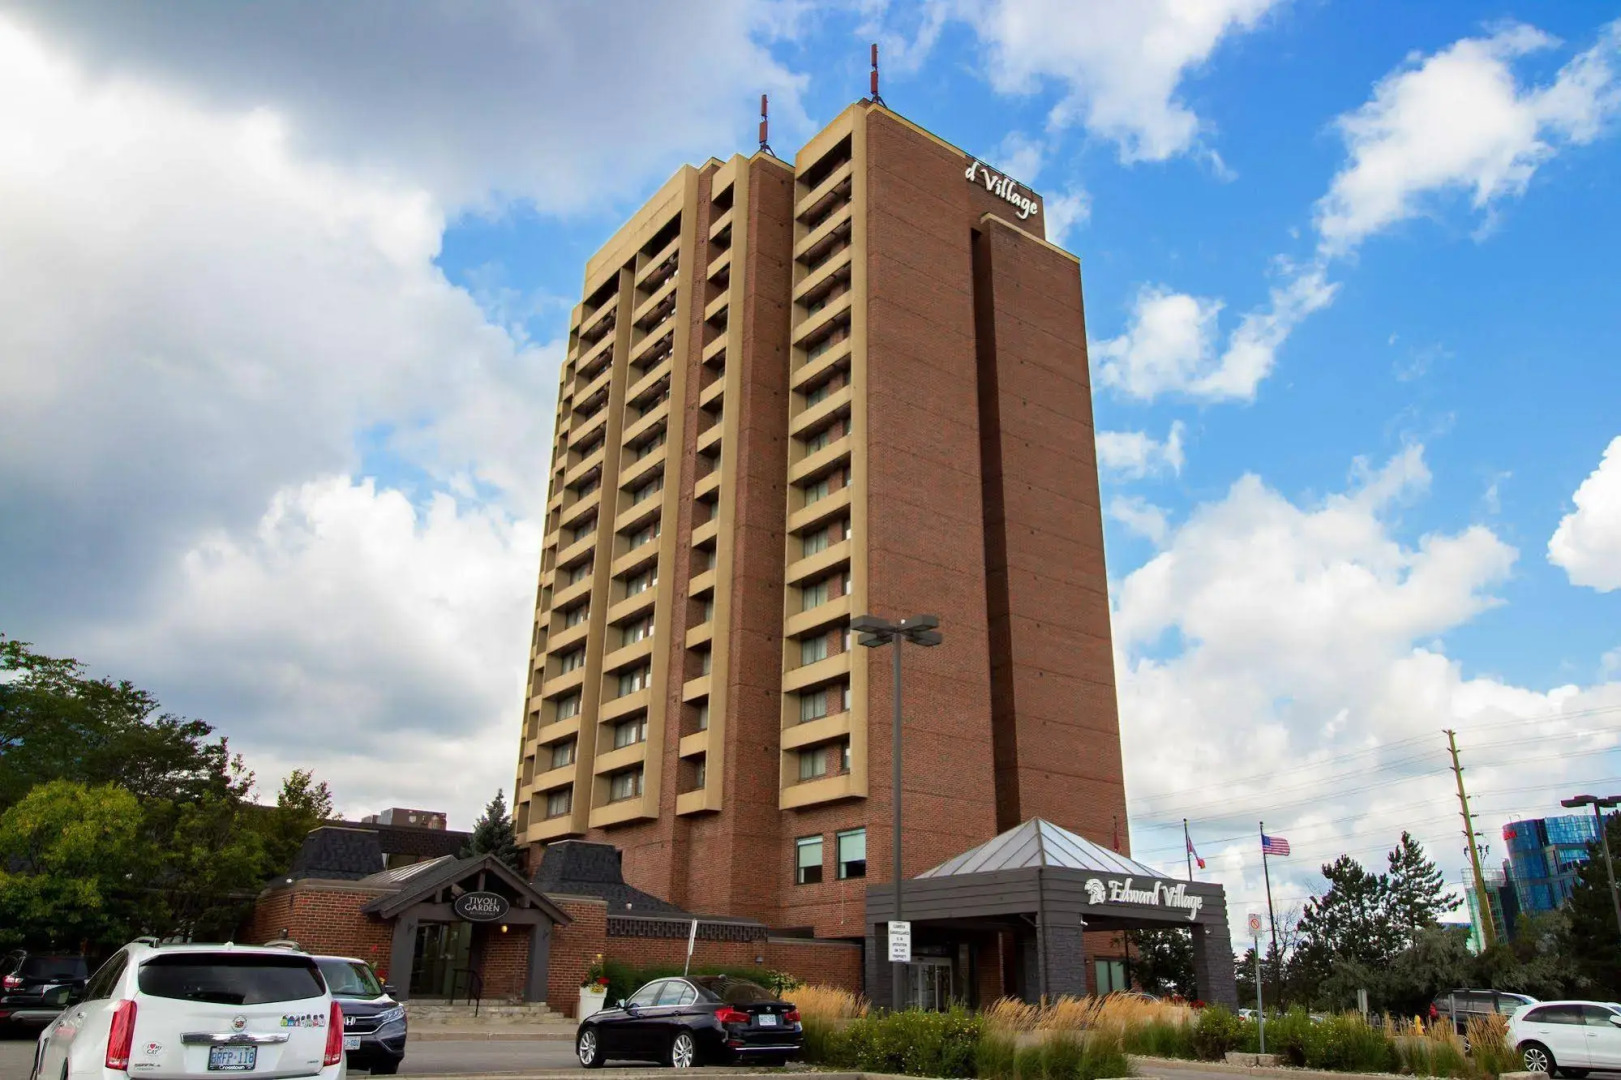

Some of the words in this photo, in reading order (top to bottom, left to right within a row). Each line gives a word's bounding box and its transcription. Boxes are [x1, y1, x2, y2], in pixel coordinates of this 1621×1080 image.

[980, 168, 1038, 219] Village
[464, 903, 500, 912] GARDEN
[469, 896, 497, 905] TIVOLI
[1108, 878, 1162, 905] Edward
[1160, 883, 1203, 920] Village
